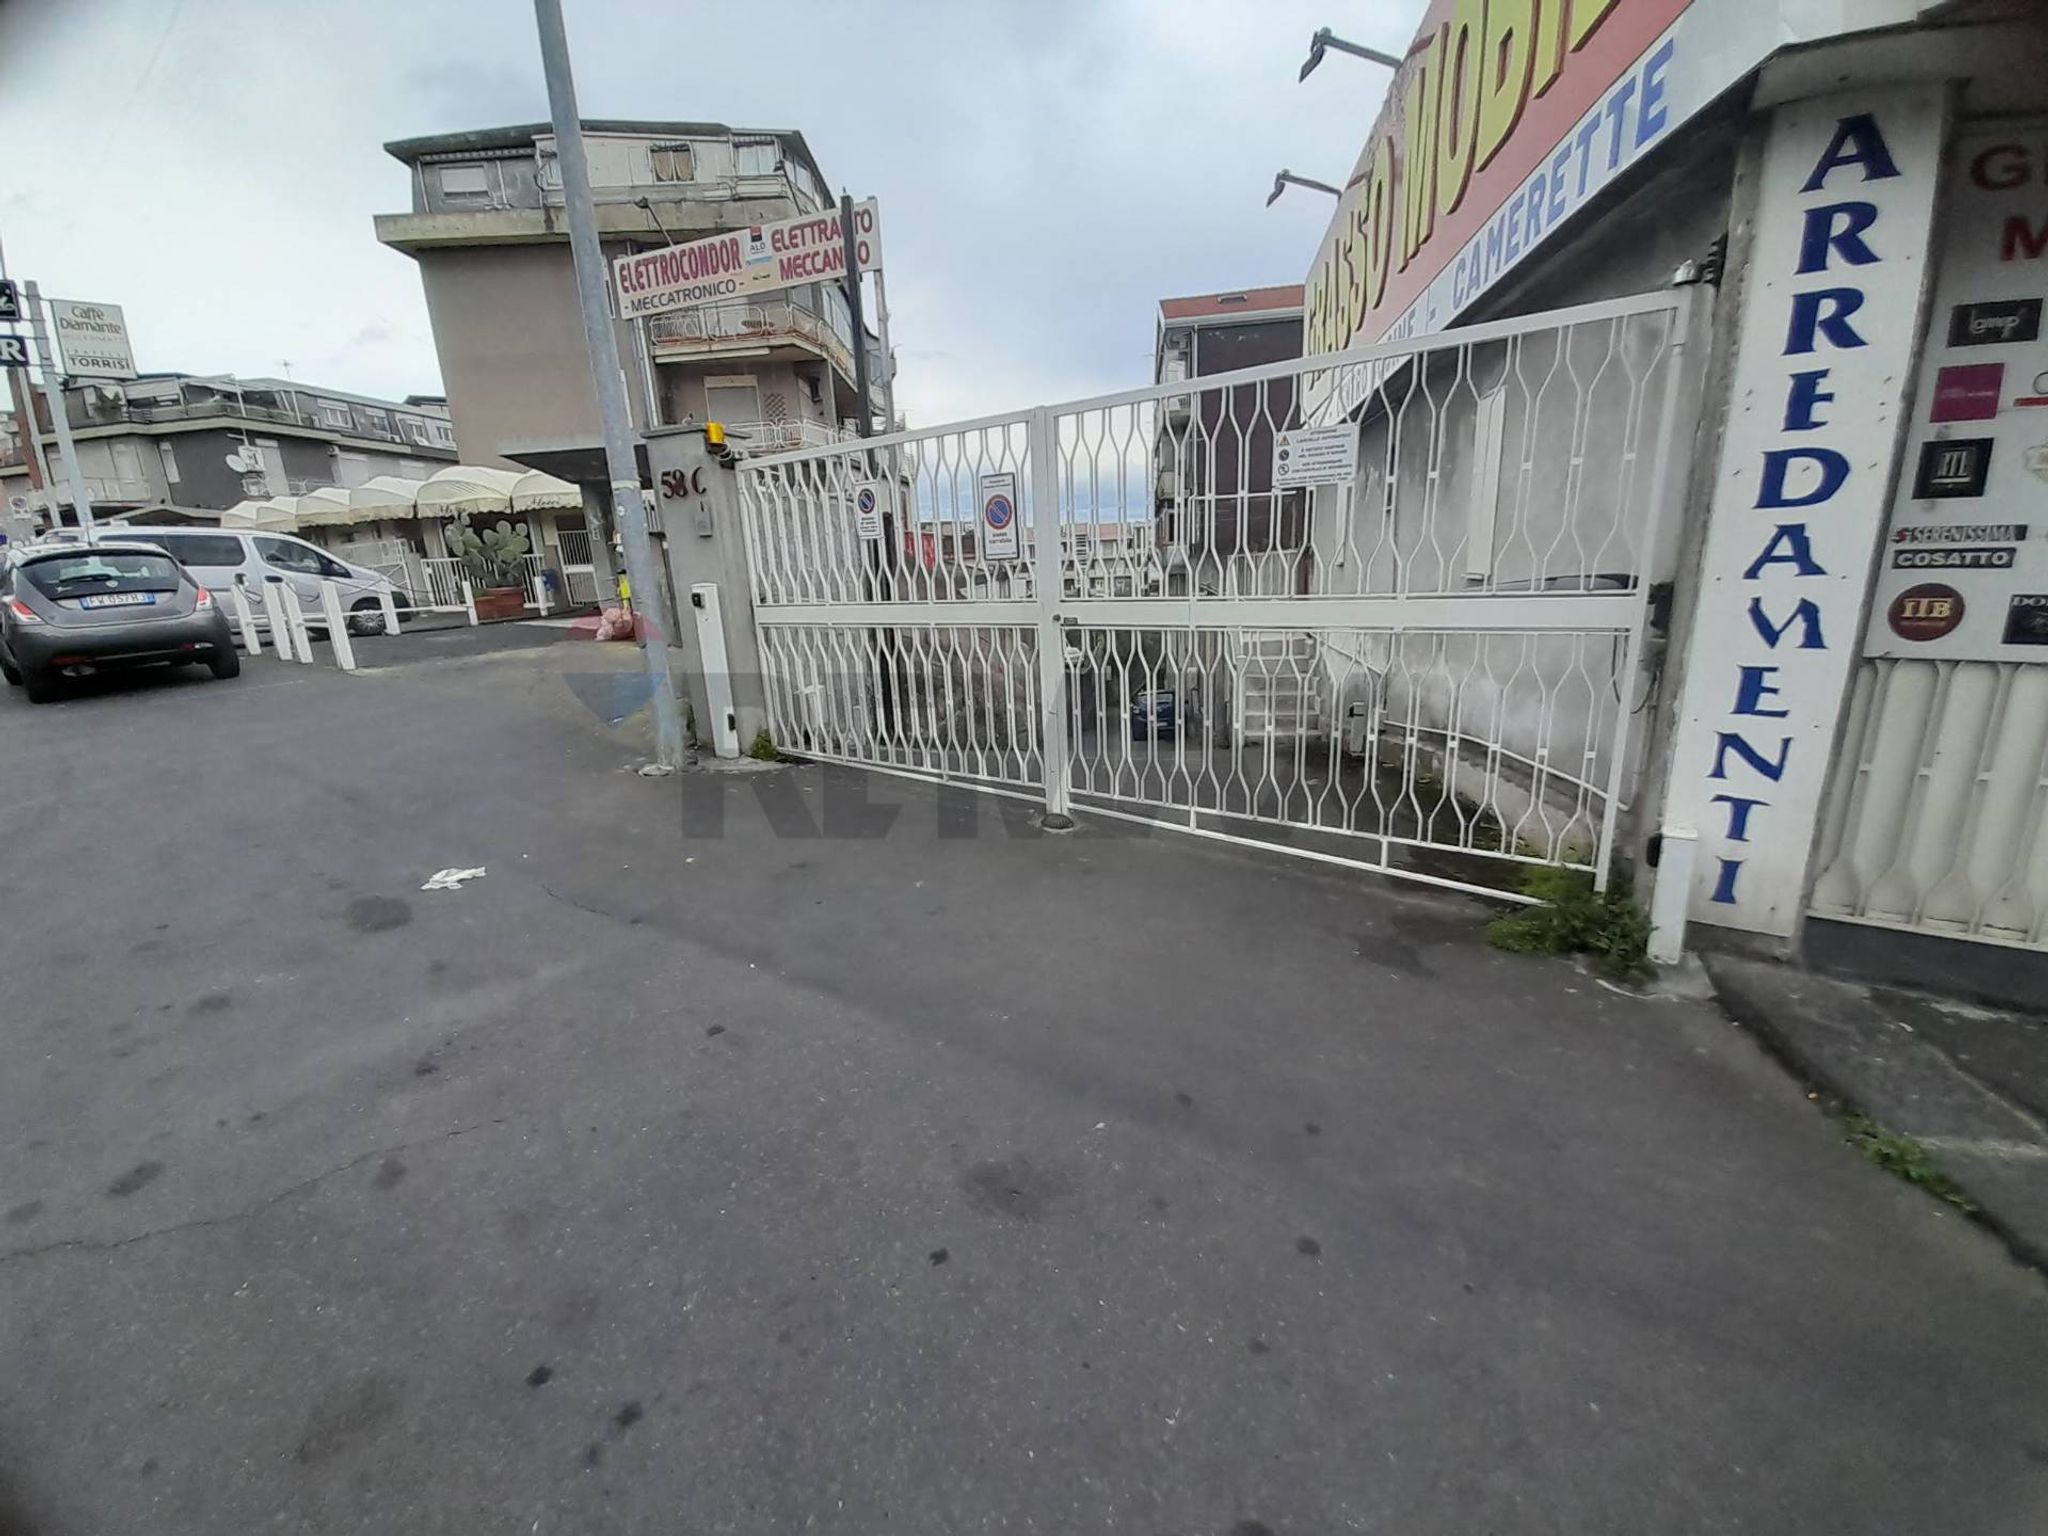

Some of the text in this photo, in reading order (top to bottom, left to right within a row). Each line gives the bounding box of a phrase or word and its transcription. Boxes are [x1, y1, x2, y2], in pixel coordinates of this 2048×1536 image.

[1451, 36, 1675, 310] CAMERETTE
[771, 207, 874, 253] ELETTRATO
[618, 236, 743, 295] ELETTROCONDOR
[778, 240, 870, 282] MECCANO
[630, 278, 737, 313] MECCATRONICO
[60, 317, 122, 335] Diamante
[70, 357, 132, 371] TORRISI
[661, 469, 688, 499] 58
[1707, 112, 1903, 905] ARREDAMENTI
[1896, 551, 2010, 567] COSATTO
[2012, 595, 2048, 607] DO
